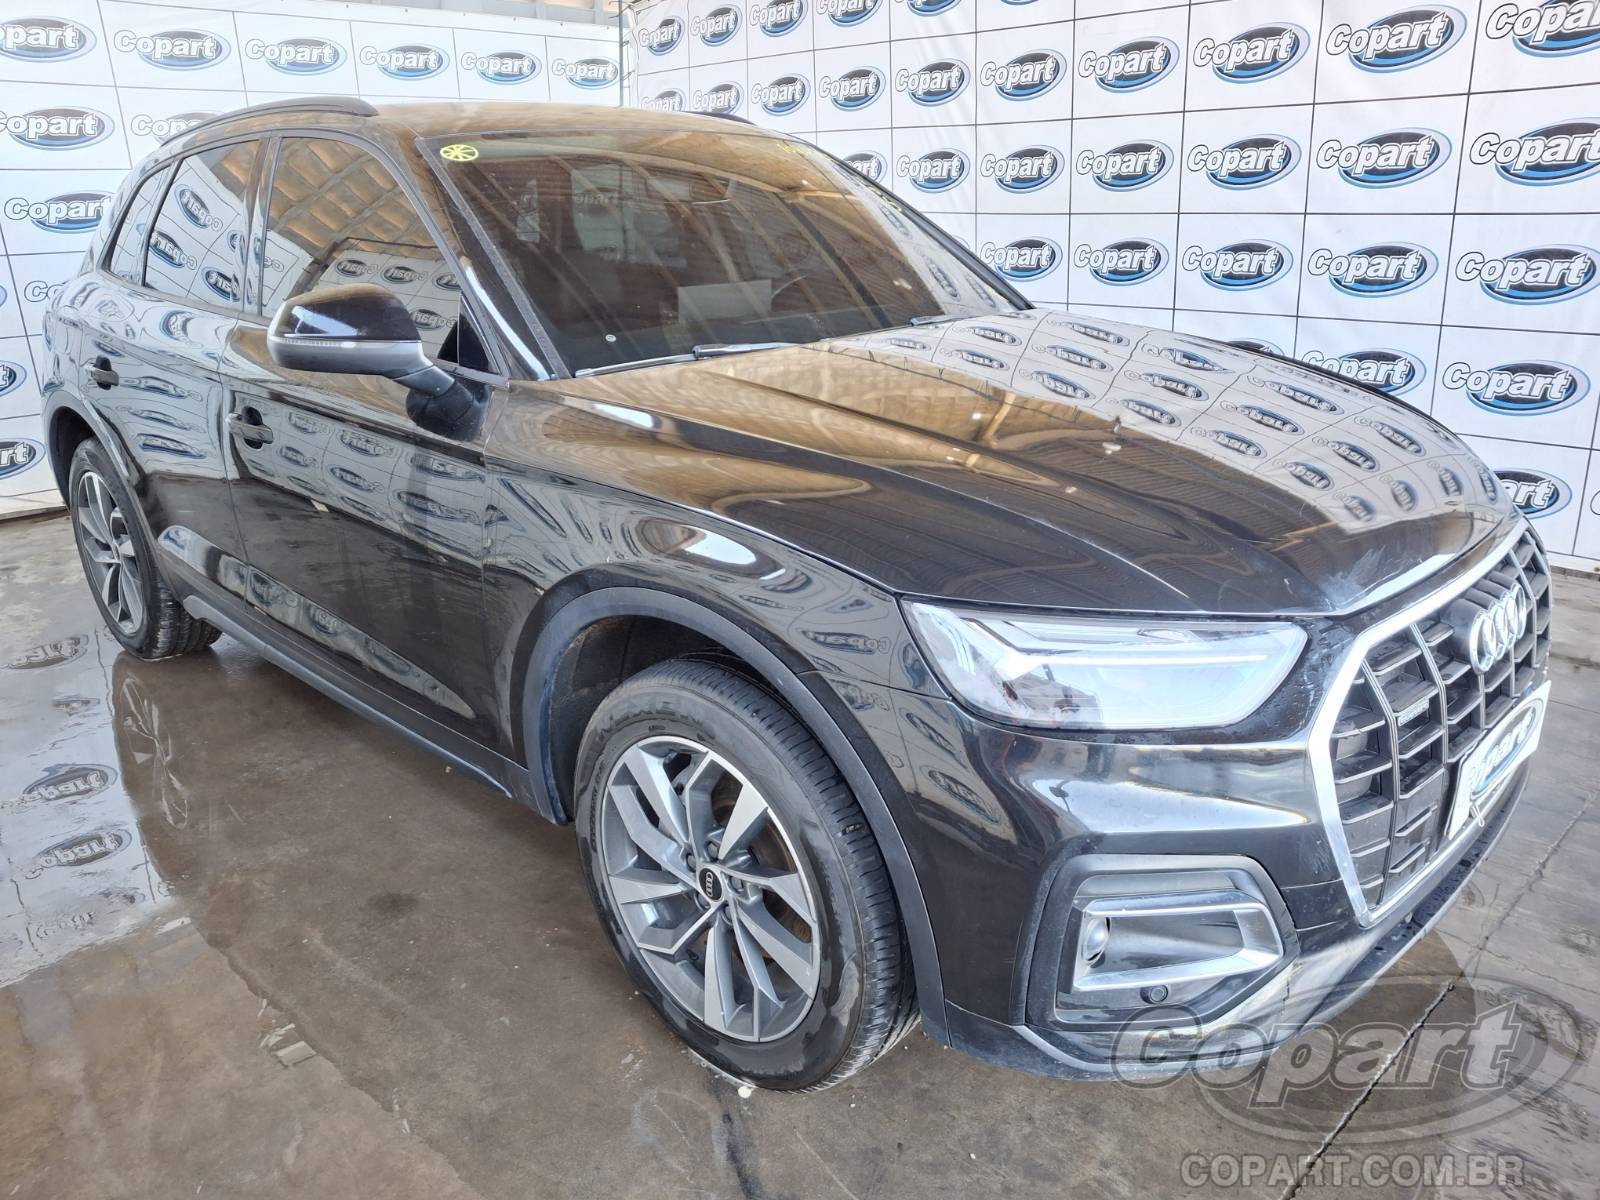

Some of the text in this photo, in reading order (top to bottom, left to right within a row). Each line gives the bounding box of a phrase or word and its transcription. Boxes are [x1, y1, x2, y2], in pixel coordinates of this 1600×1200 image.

[690, 8, 737, 40] Copart
[750, 0, 800, 29] Copart
[0, 24, 79, 49] part
[114, 30, 216, 58] Copart
[245, 39, 334, 65] Copart
[1193, 28, 1296, 73] Copart
[1326, 12, 1449, 61] Copart
[360, 46, 439, 70] Copart
[461, 52, 532, 75] Copart
[552, 58, 615, 81] Copart
[980, 55, 1056, 90] Copart
[1078, 42, 1166, 84] Copart
[751, 77, 804, 108] Copart
[818, 71, 878, 101] Copart
[895, 64, 962, 96] Copart
[693, 86, 737, 112] Copart
[1076, 146, 1160, 180] Copart
[1187, 141, 1287, 178] Copart
[1316, 135, 1435, 175] Copart
[1470, 129, 1600, 172] Copart
[897, 154, 961, 182] Copart
[980, 151, 1054, 182] Copart
[980, 242, 1051, 270] Copart
[1074, 243, 1156, 273] Copart
[1182, 245, 1280, 278] Copart
[1308, 248, 1421, 284] Copart
[1456, 252, 1588, 290] Copart
[1443, 361, 1577, 400] Copart
